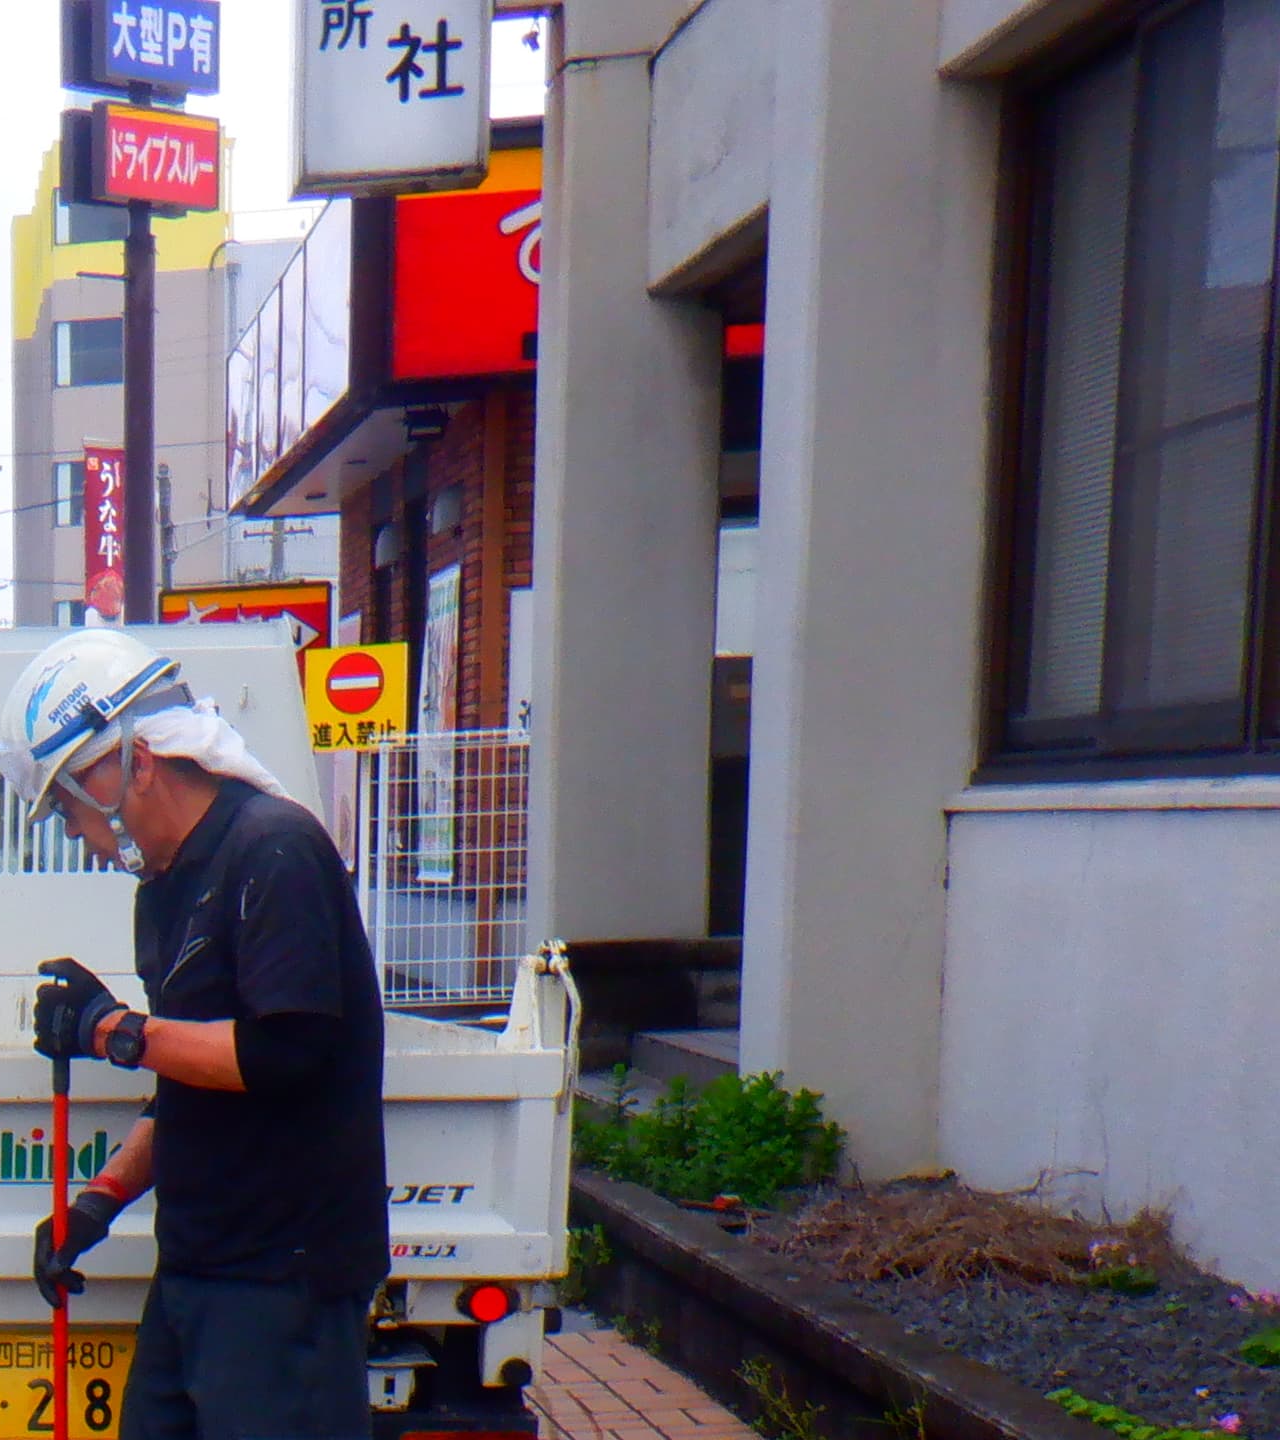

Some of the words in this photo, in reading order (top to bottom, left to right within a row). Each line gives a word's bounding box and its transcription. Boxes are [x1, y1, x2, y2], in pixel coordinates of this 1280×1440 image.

[111, 1, 214, 75] 大型P有
[385, 16, 466, 104] 社
[111, 127, 214, 187] ドライブスルー
[312, 719, 400, 749] 進入禁止
